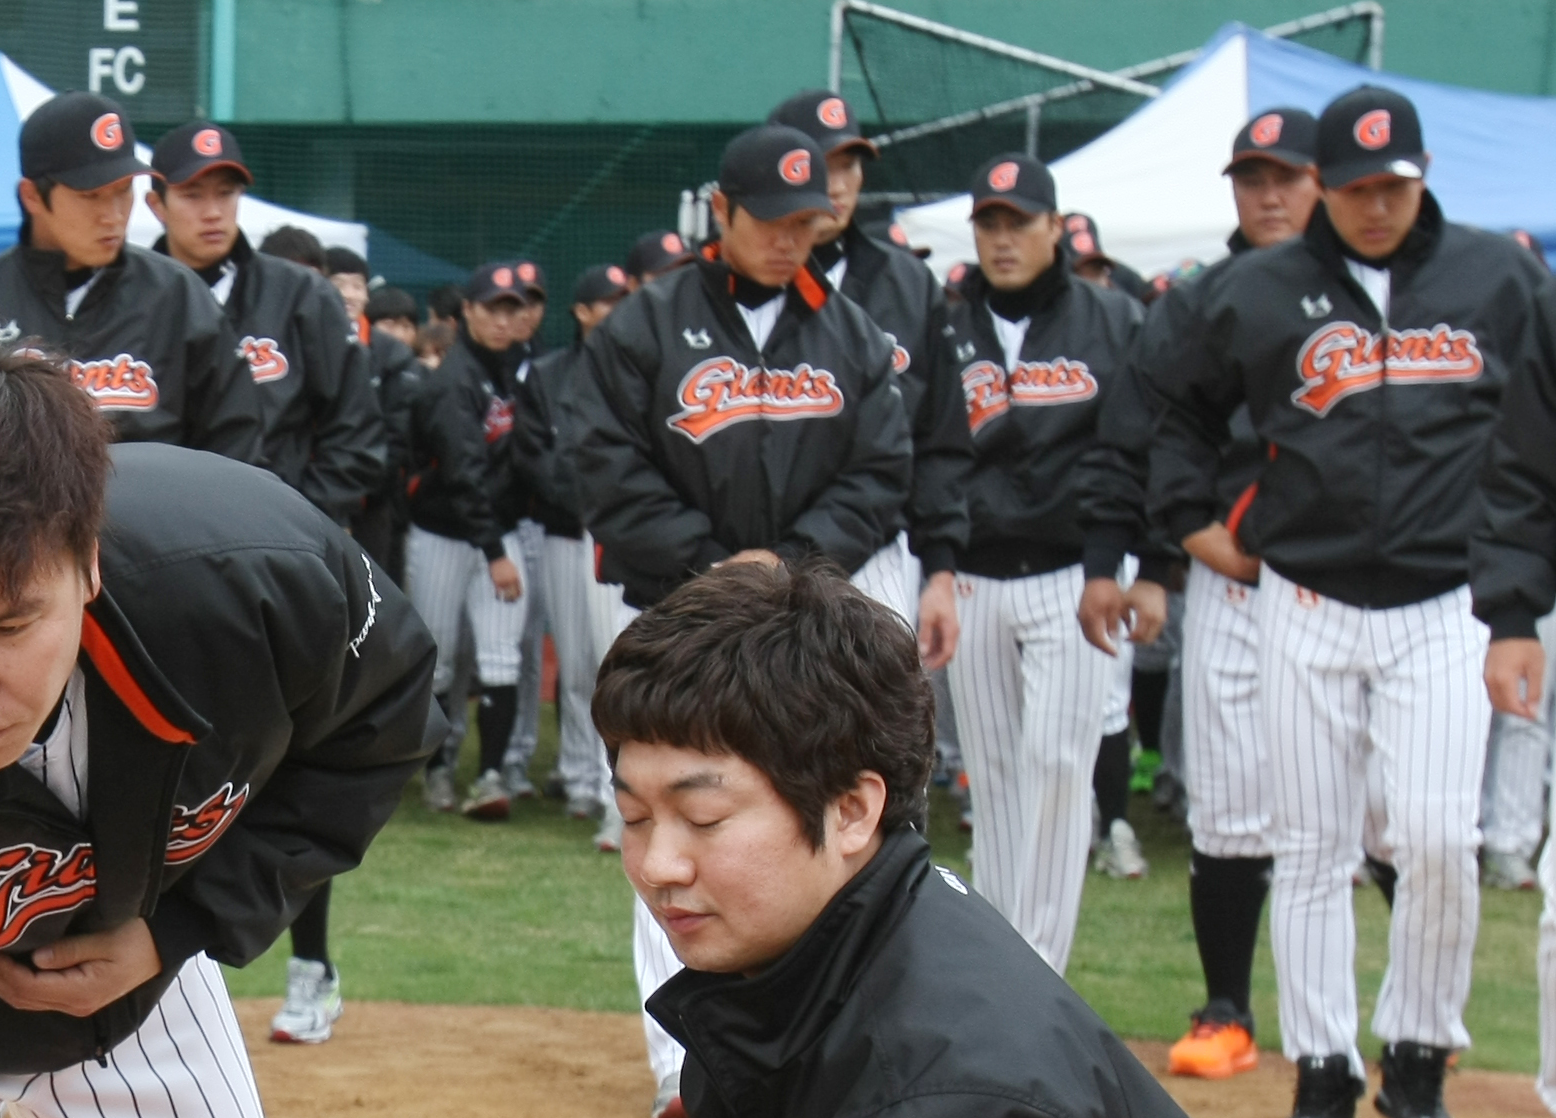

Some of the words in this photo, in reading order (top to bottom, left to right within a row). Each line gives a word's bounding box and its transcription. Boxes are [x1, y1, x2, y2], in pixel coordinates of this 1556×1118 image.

[103, 0, 141, 31] E
[89, 46, 145, 95] FC
[91, 112, 125, 151] G
[817, 97, 847, 129] G
[1250, 113, 1284, 148] G
[1353, 109, 1391, 150] G
[192, 129, 223, 157] G
[778, 149, 811, 185] G
[66, 352, 159, 412] nts
[1291, 320, 1484, 419] Giants
[666, 355, 844, 444] Giants
